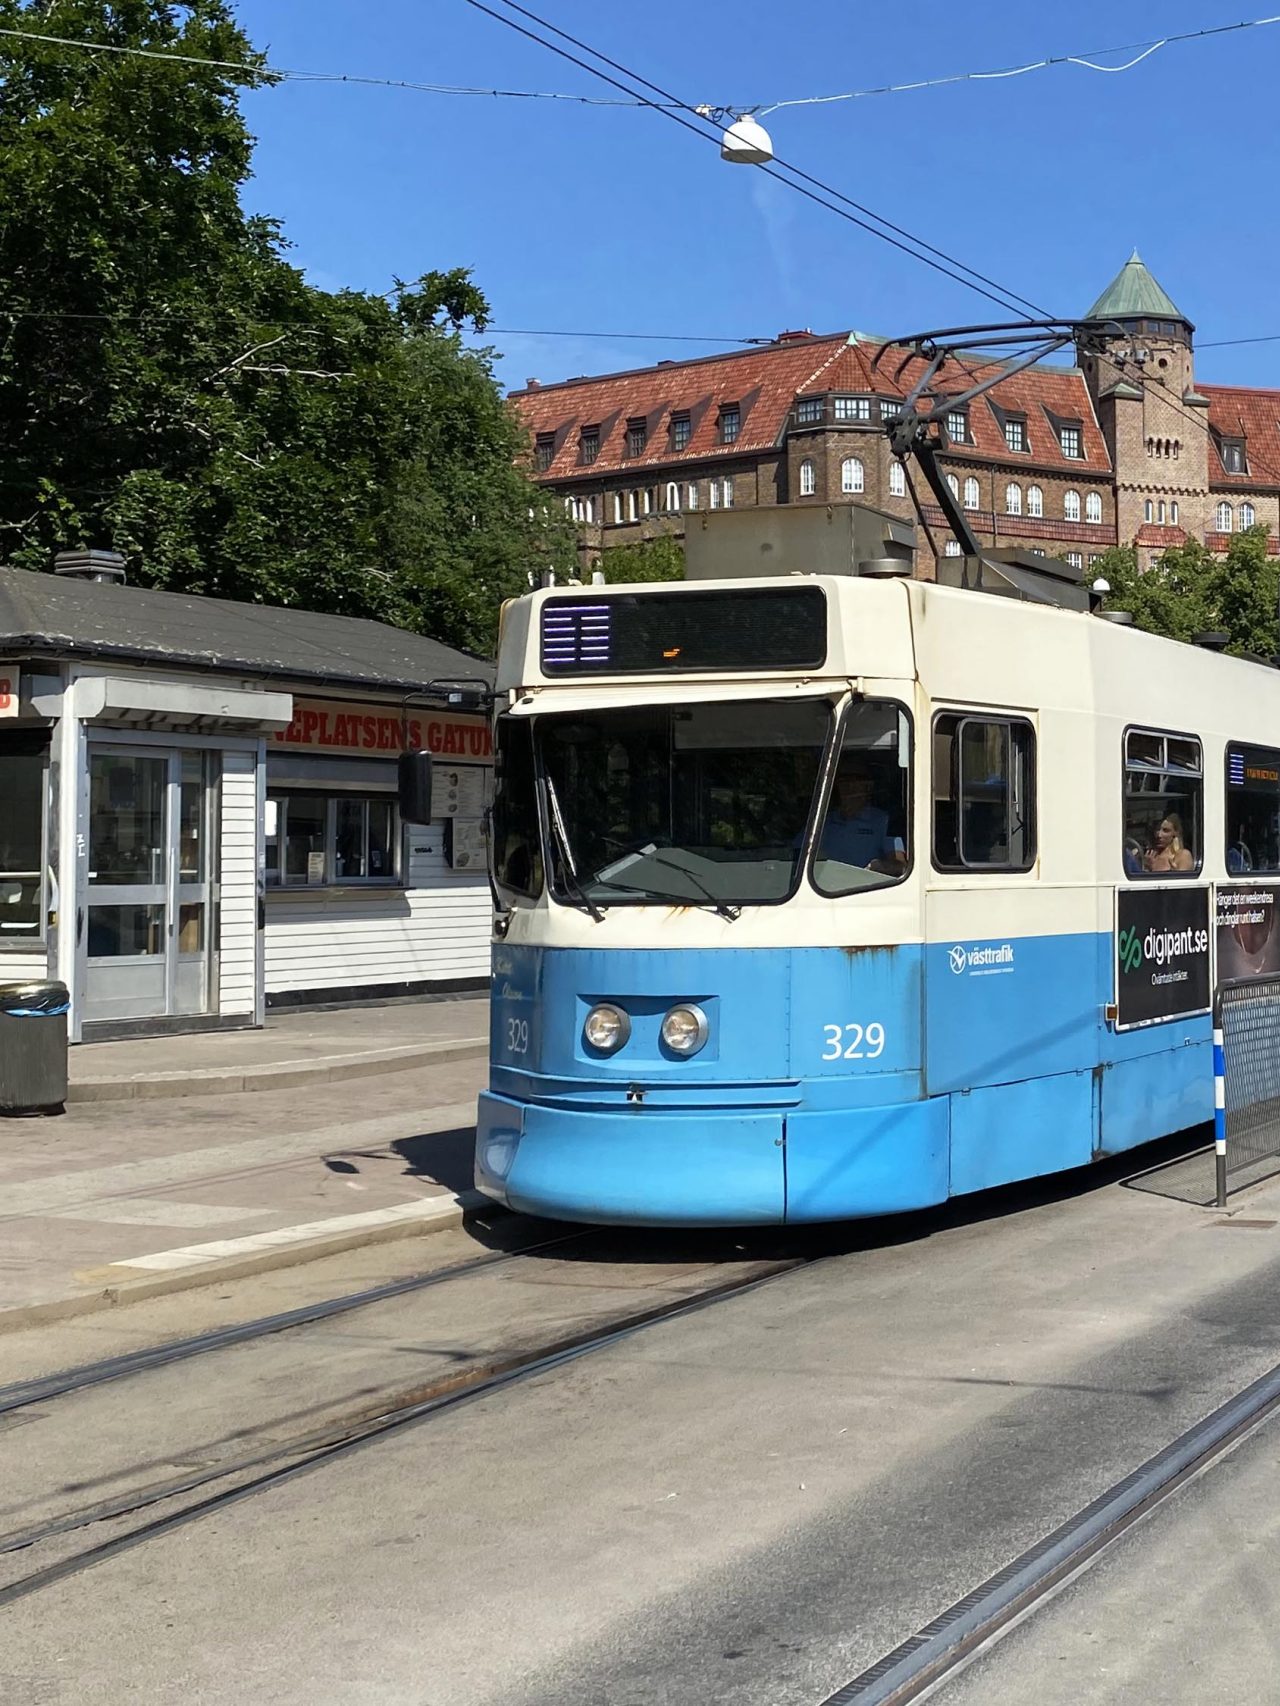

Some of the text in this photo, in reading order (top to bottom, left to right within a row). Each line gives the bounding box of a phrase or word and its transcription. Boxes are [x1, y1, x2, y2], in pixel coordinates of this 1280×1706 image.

[967, 944, 1014, 966] västtrafik
[1144, 926, 1207, 965] digipant.se
[507, 1017, 529, 1054] 329
[821, 1022, 886, 1061] 329
